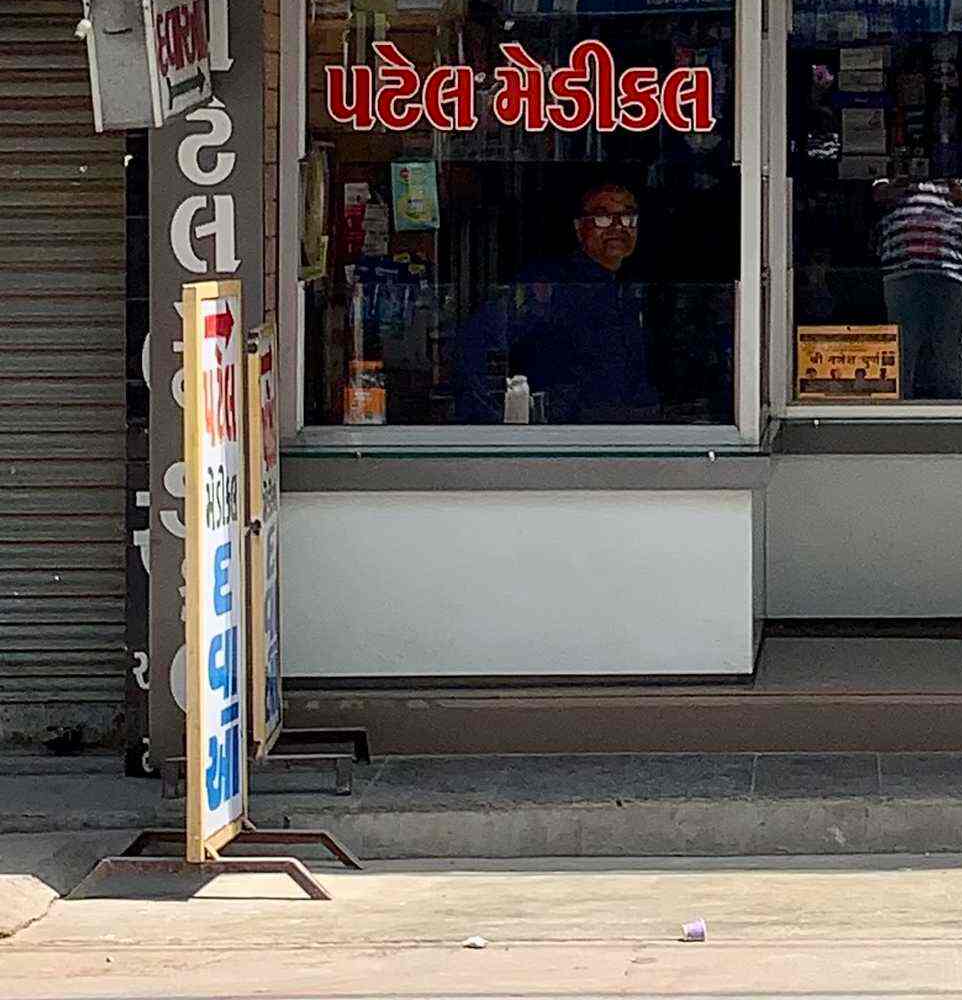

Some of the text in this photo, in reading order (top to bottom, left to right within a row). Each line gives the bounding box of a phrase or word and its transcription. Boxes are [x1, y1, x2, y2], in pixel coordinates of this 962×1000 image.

[325, 39, 717, 132] પટેલ મેડીકલ
[206, 539, 241, 814] દવાઓ
